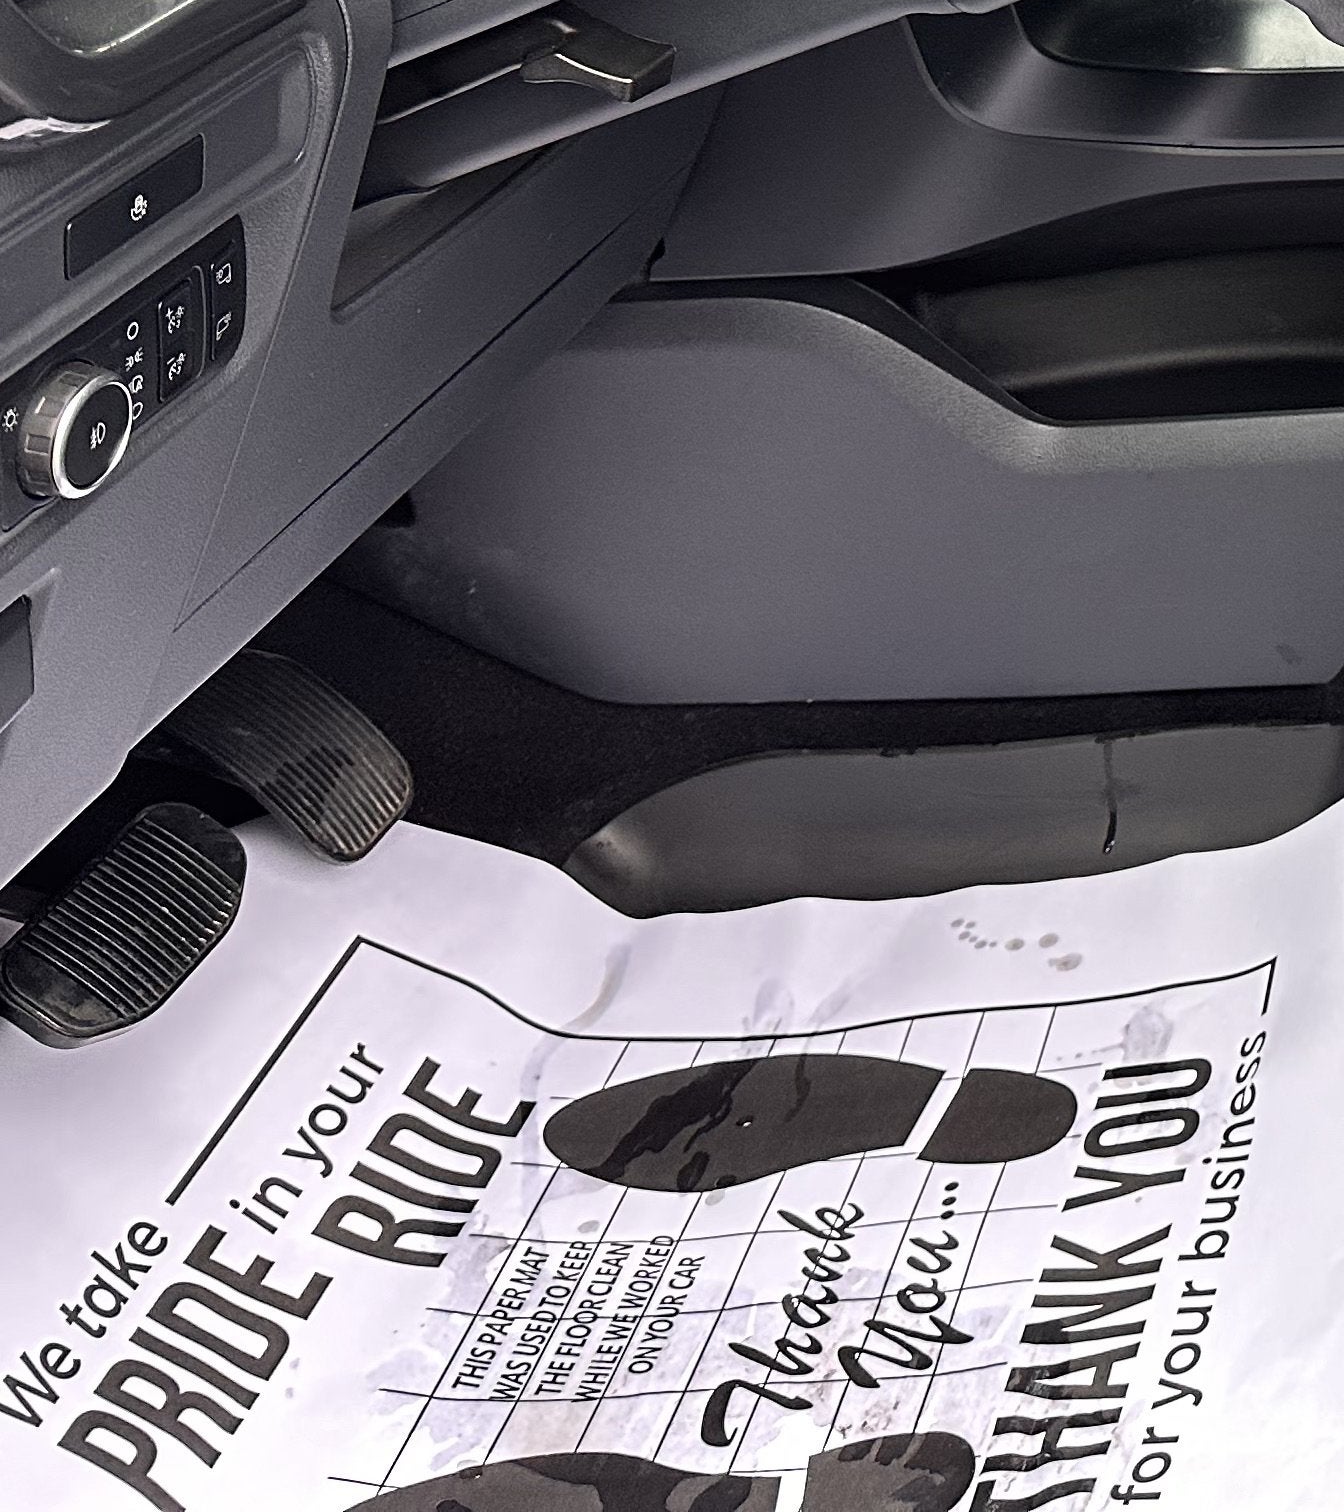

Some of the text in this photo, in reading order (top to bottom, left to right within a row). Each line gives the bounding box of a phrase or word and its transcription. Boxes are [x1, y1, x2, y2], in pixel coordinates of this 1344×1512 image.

[229, 1042, 384, 1234] in your
[311, 1056, 537, 1267] RIDE
[1061, 1058, 1212, 1212] YOU
[0, 1221, 168, 1428] We take
[451, 1246, 550, 1389] THIS PAPER MAT
[489, 1240, 592, 1402] WAS USED TO KEEP
[534, 1241, 635, 1395] THE FLOOR CLEAN
[571, 1235, 675, 1403] WHILE WE WORKED
[628, 1255, 705, 1374] ON YOUR CAR
[701, 1202, 865, 1447] Thank
[1111, 1030, 1267, 1506] for your business
[57, 1224, 334, 1512] PRIDE
